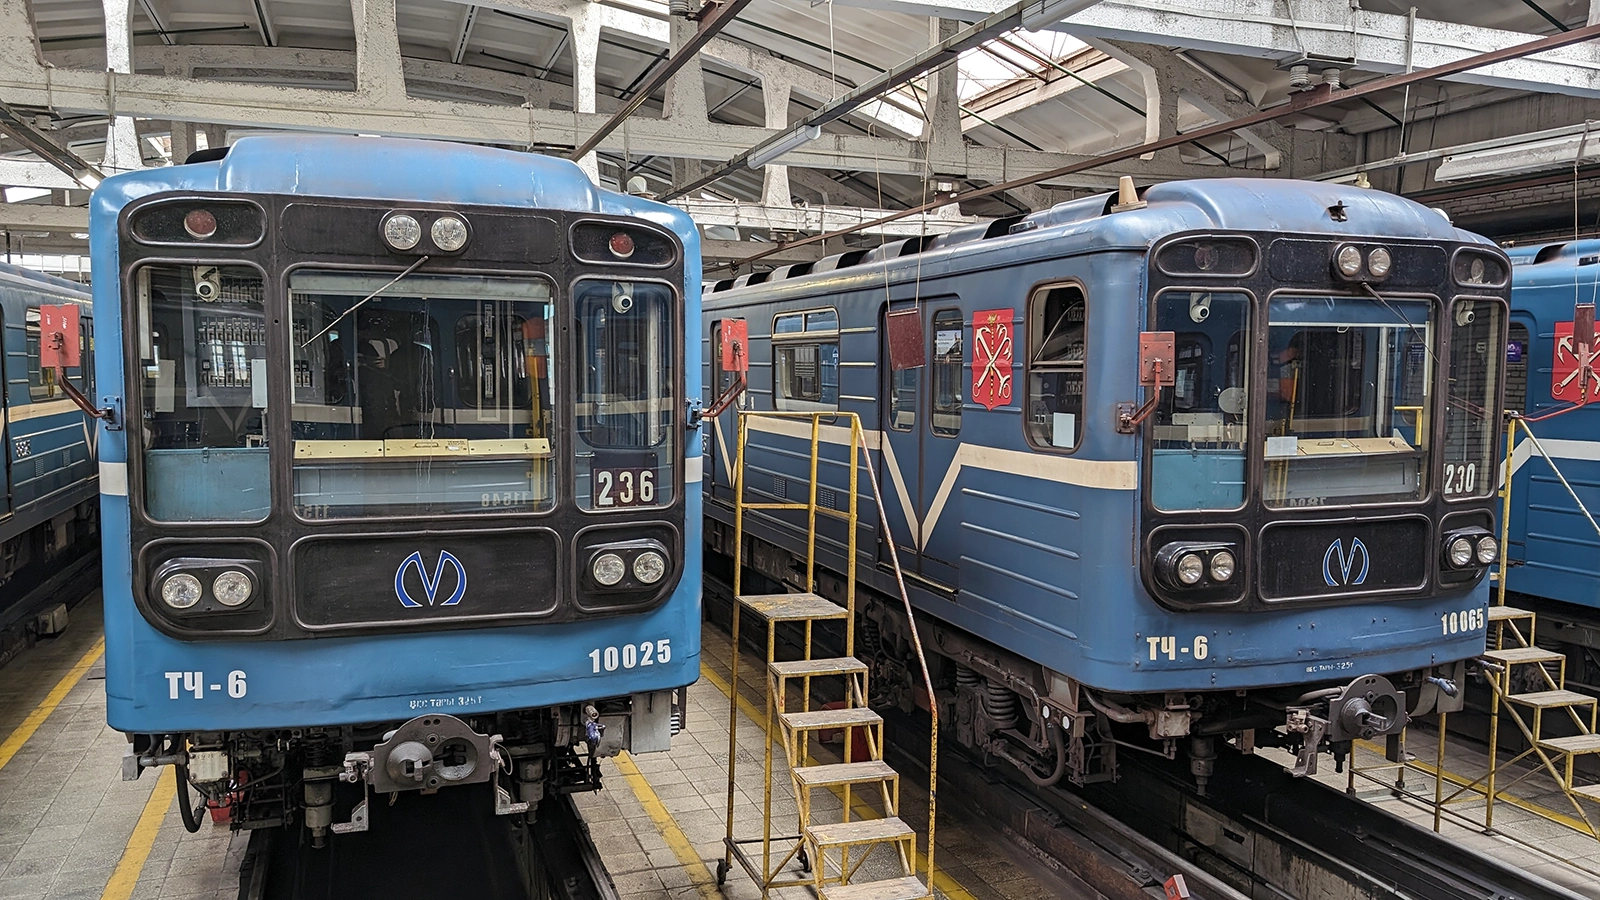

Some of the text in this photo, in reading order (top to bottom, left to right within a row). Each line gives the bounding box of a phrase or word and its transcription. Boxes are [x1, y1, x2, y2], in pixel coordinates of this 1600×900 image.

[598, 470, 654, 505] 236
[1444, 463, 1475, 494] 230
[1440, 607, 1484, 636] 10065
[588, 638, 671, 674] 10025
